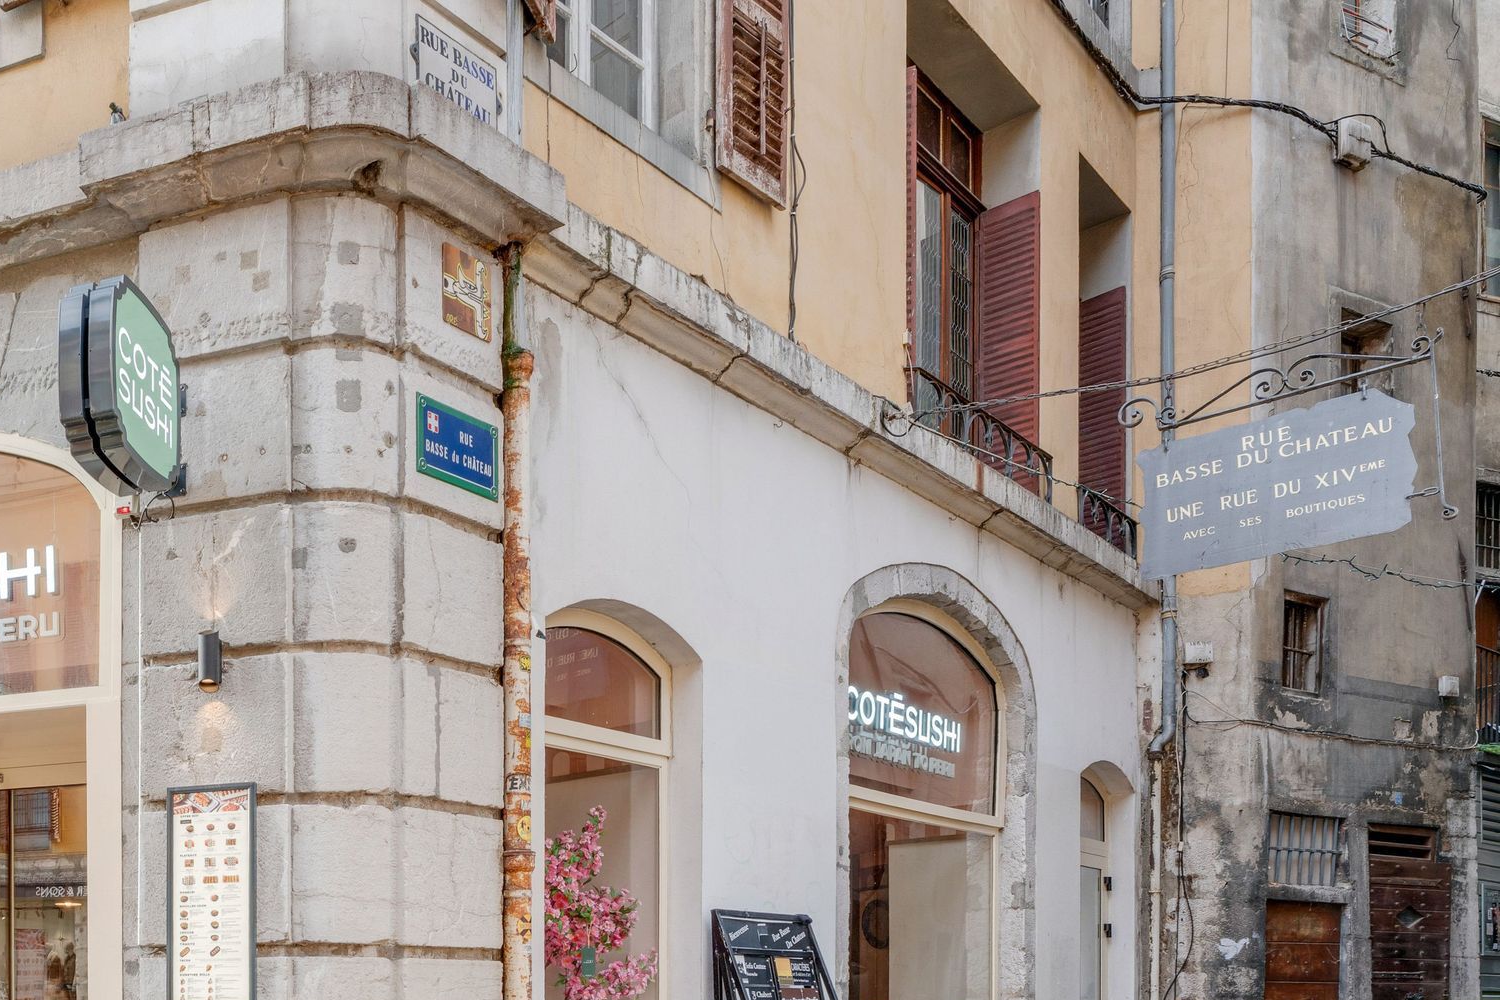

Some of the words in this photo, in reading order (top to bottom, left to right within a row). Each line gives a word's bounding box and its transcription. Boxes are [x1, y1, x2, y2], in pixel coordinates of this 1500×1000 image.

[419, 25, 449, 59] RUE
[452, 47, 495, 90] BASSE
[451, 68, 468, 90] DU
[118, 367, 173, 448] SUSHI
[425, 438, 449, 460] BASSE
[451, 450, 460, 465] du
[462, 454, 493, 477] CHÂTEAU
[459, 430, 474, 448] RUE
[1156, 459, 1224, 489] BASSE
[1236, 447, 1269, 469] DU
[1278, 416, 1394, 458] CHATEAU
[1241, 425, 1293, 452] RUE
[1166, 501, 1205, 523] UNE
[1219, 488, 1259, 511] RUE
[1273, 478, 1302, 499] DU
[1183, 525, 1216, 541] AVEC
[1239, 514, 1263, 528] SES
[1285, 493, 1366, 519] BOUTIQUES
